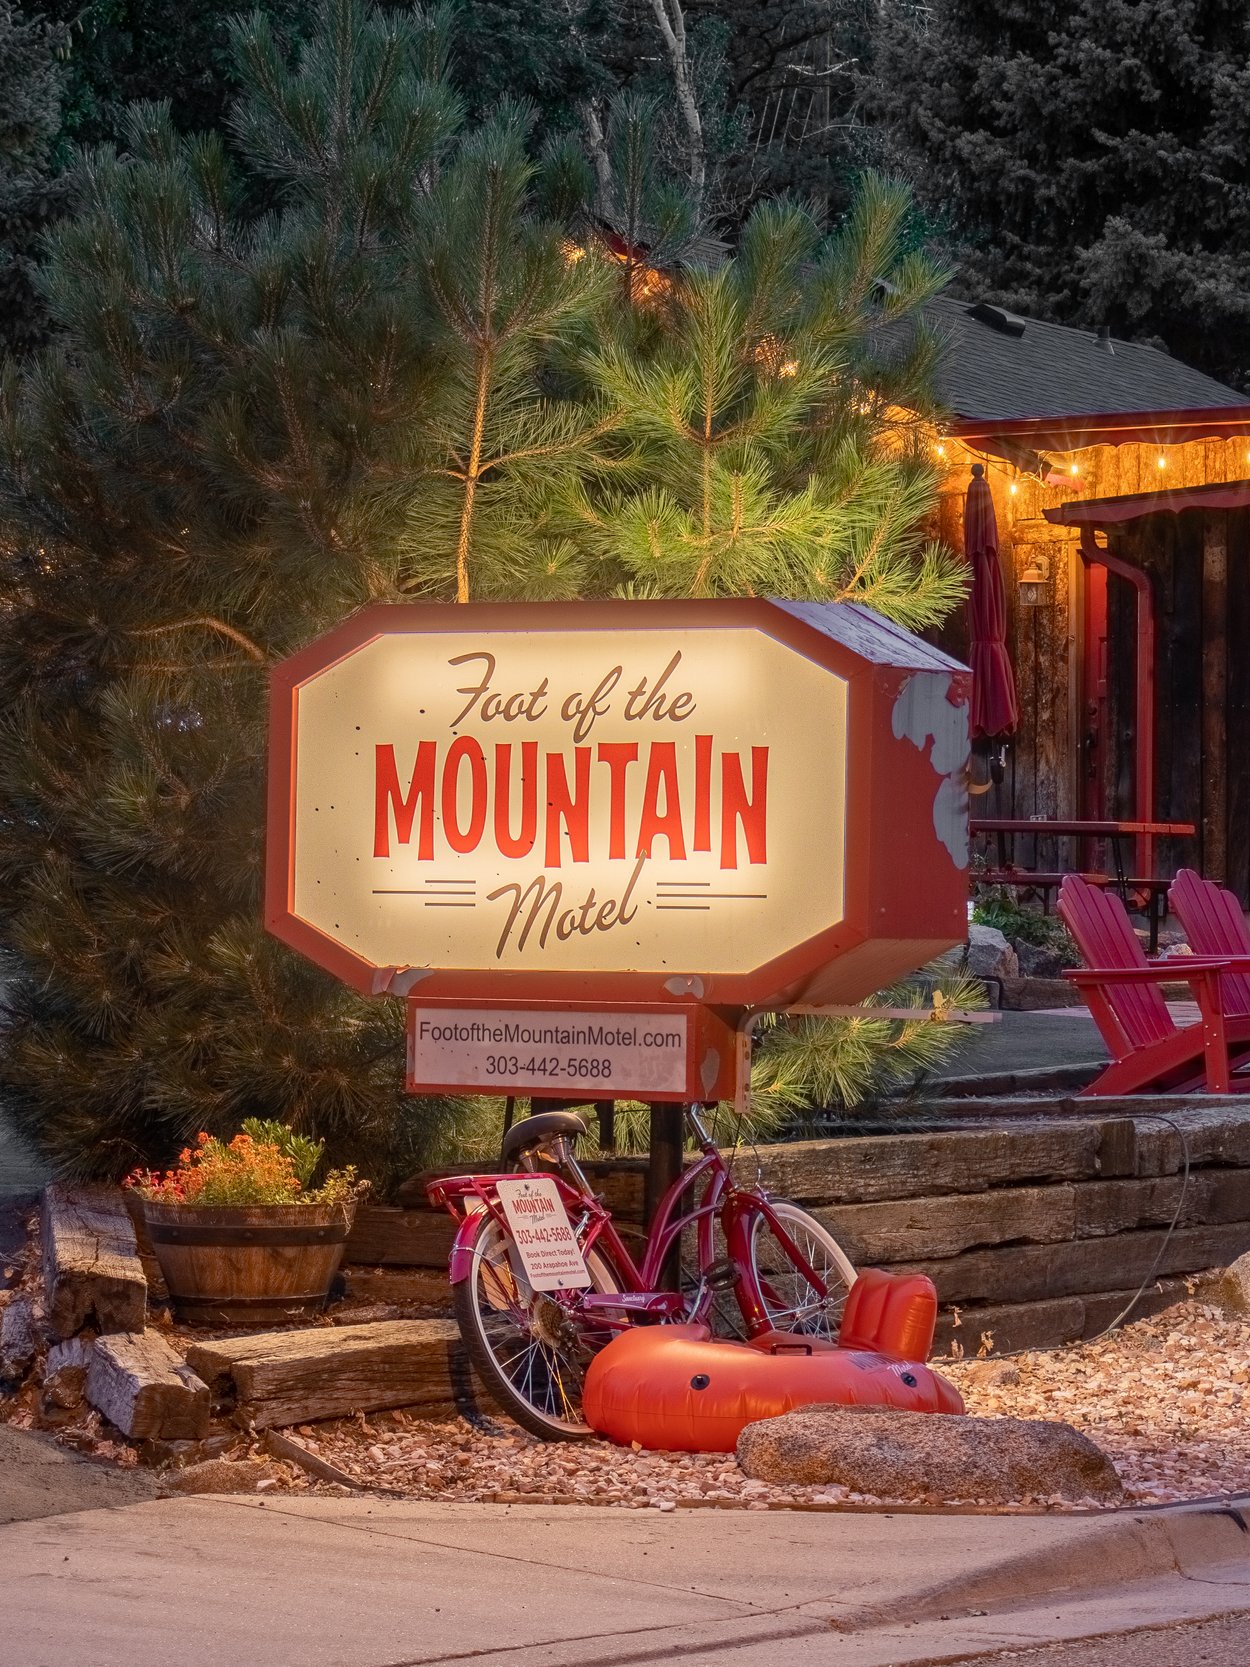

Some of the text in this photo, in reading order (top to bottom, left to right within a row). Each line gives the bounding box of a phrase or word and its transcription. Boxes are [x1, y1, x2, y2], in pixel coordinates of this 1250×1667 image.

[447, 649, 697, 744] Foot of the
[372, 734, 770, 870] MOUNTAIN
[485, 849, 646, 960] Motel
[419, 1021, 682, 1048] FootoftheMountainMotel.com
[485, 1055, 613, 1079] 303-442-5688
[516, 1188, 542, 1200] Foot of the
[512, 1198, 555, 1214] MOUNTAIN
[529, 1211, 545, 1225] Motel
[516, 1226, 572, 1244] 303-442-5688
[526, 1249, 575, 1259] Book Direct Today!
[530, 1259, 579, 1270] 200 Arapahoe Ave
